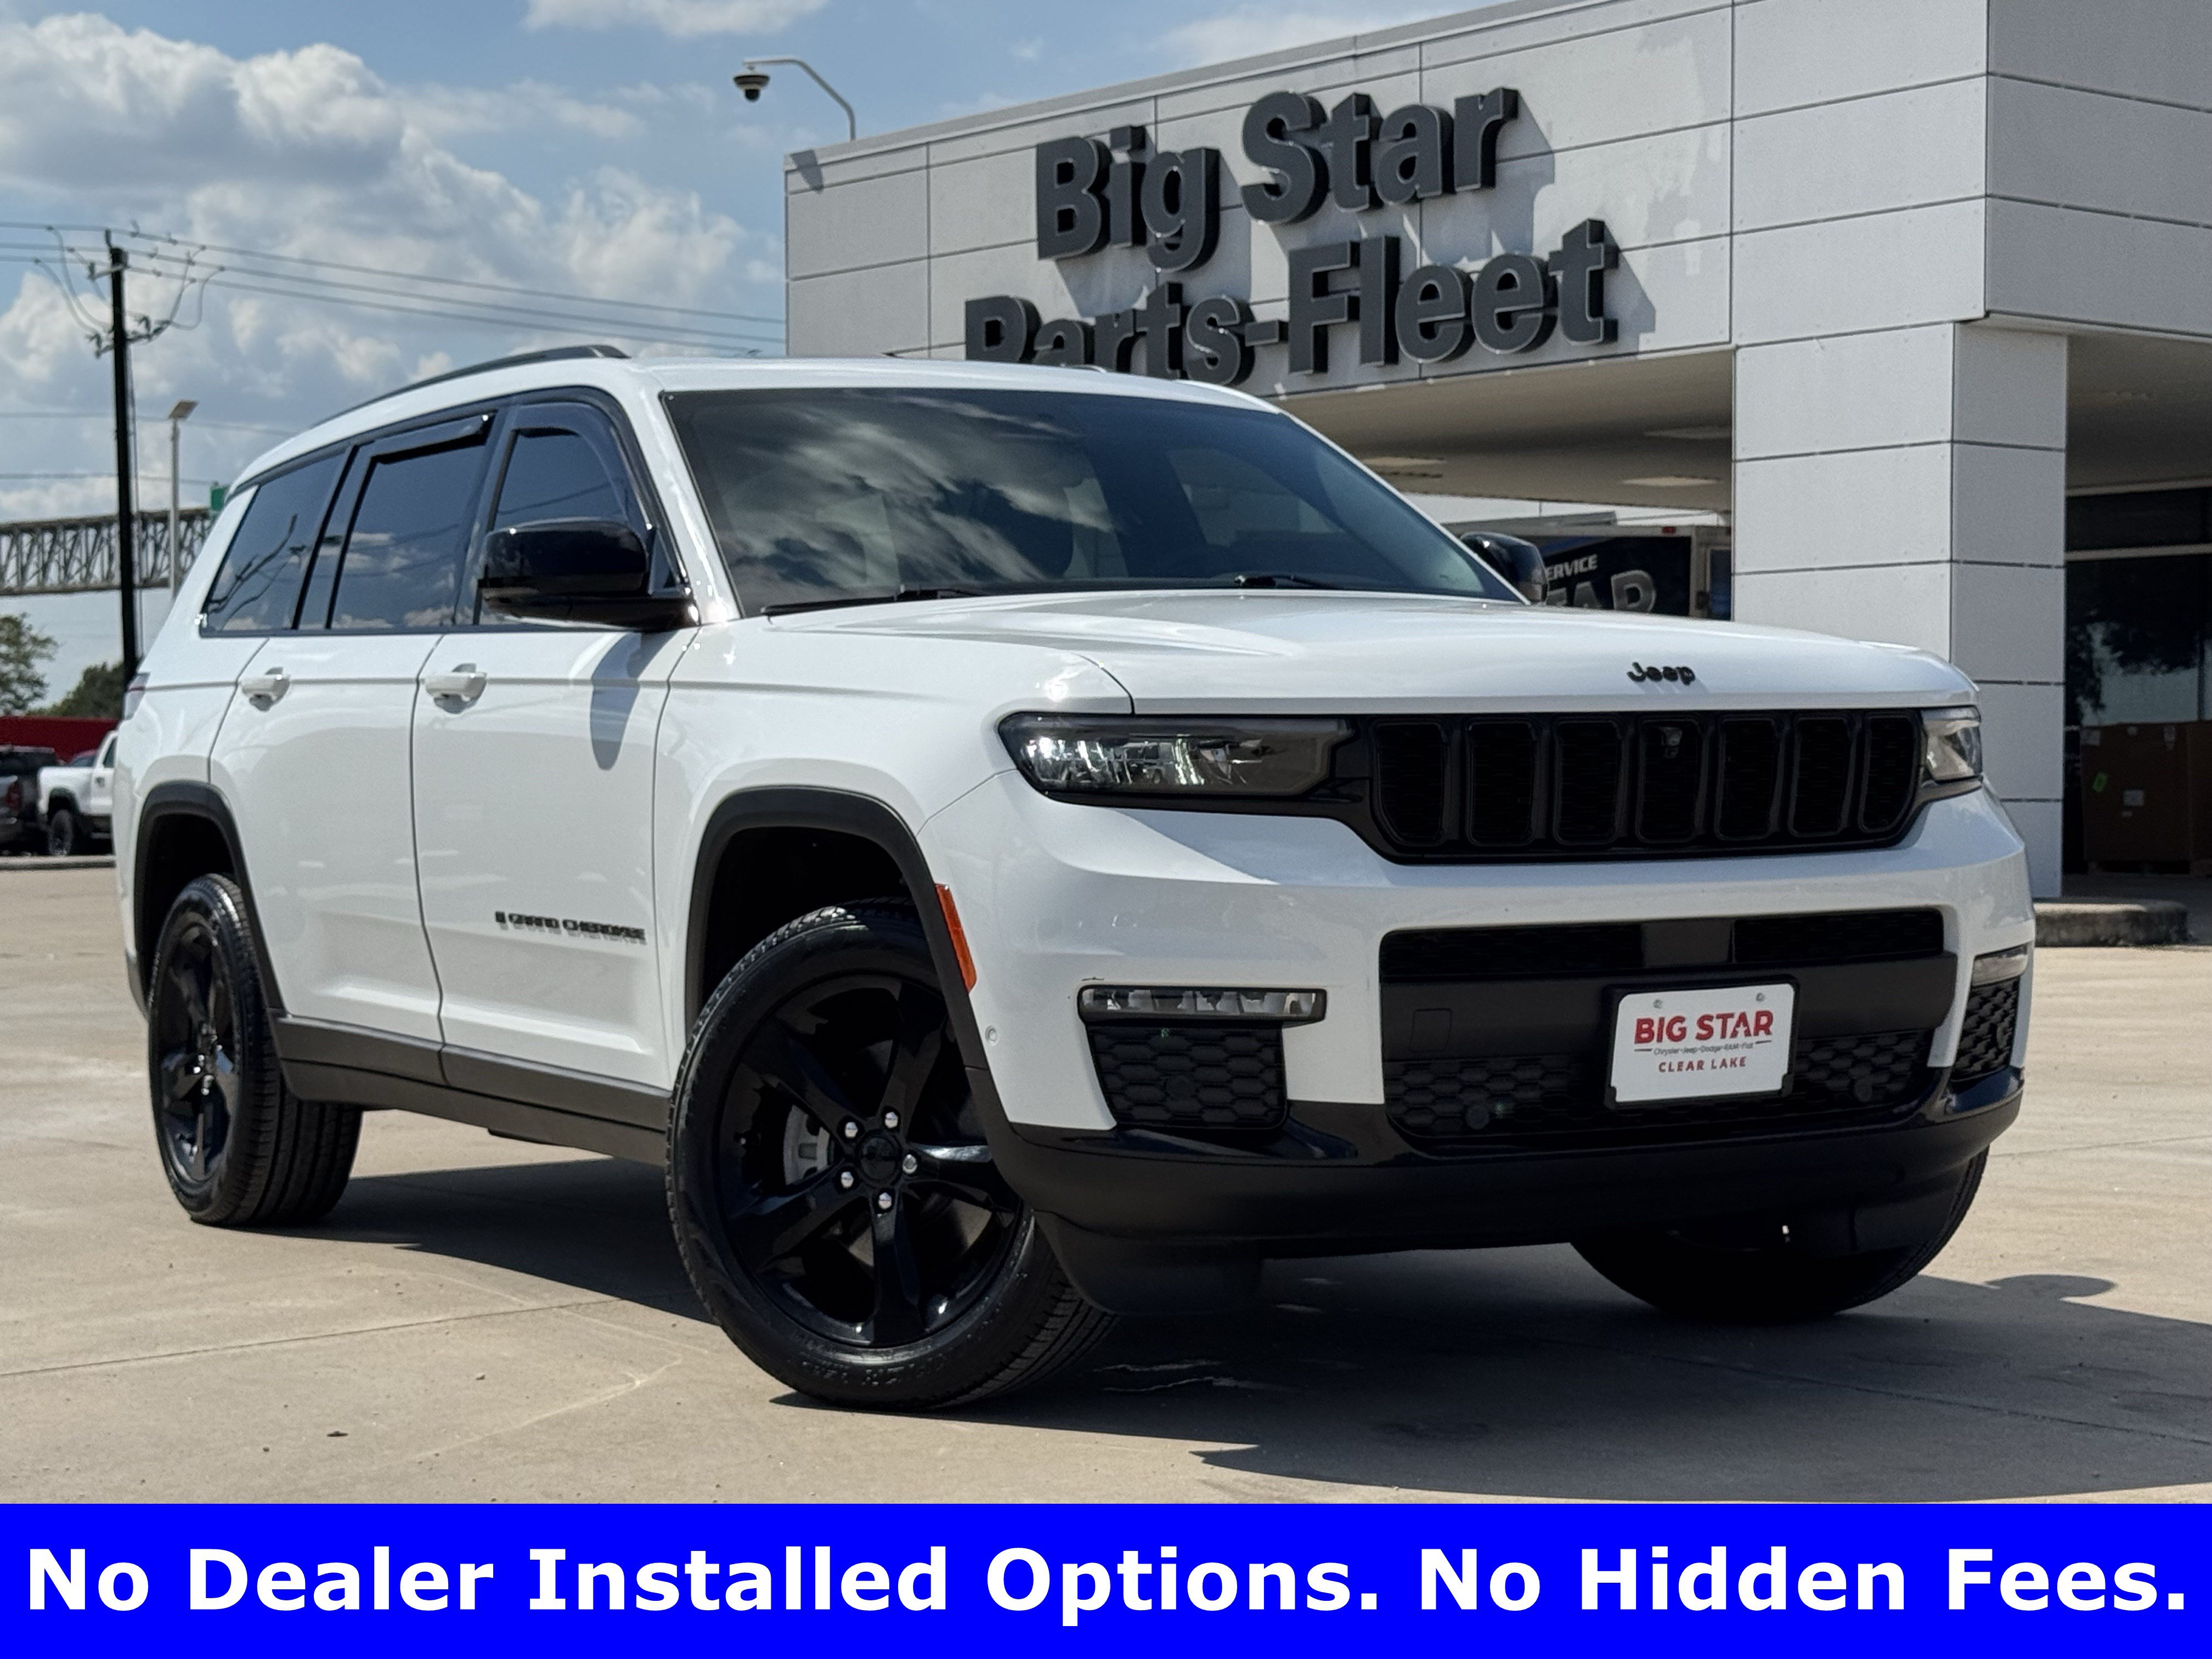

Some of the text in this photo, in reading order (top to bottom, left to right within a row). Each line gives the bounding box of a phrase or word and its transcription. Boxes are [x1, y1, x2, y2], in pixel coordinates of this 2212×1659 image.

[1037, 87, 1519, 272] Big Star
[1545, 554, 1598, 580] ERVICE
[1627, 662, 1696, 686] Jeep
[1634, 1010, 1773, 1045] BIG STAR
[1658, 1056, 1747, 1073] CLEAR LAKE
